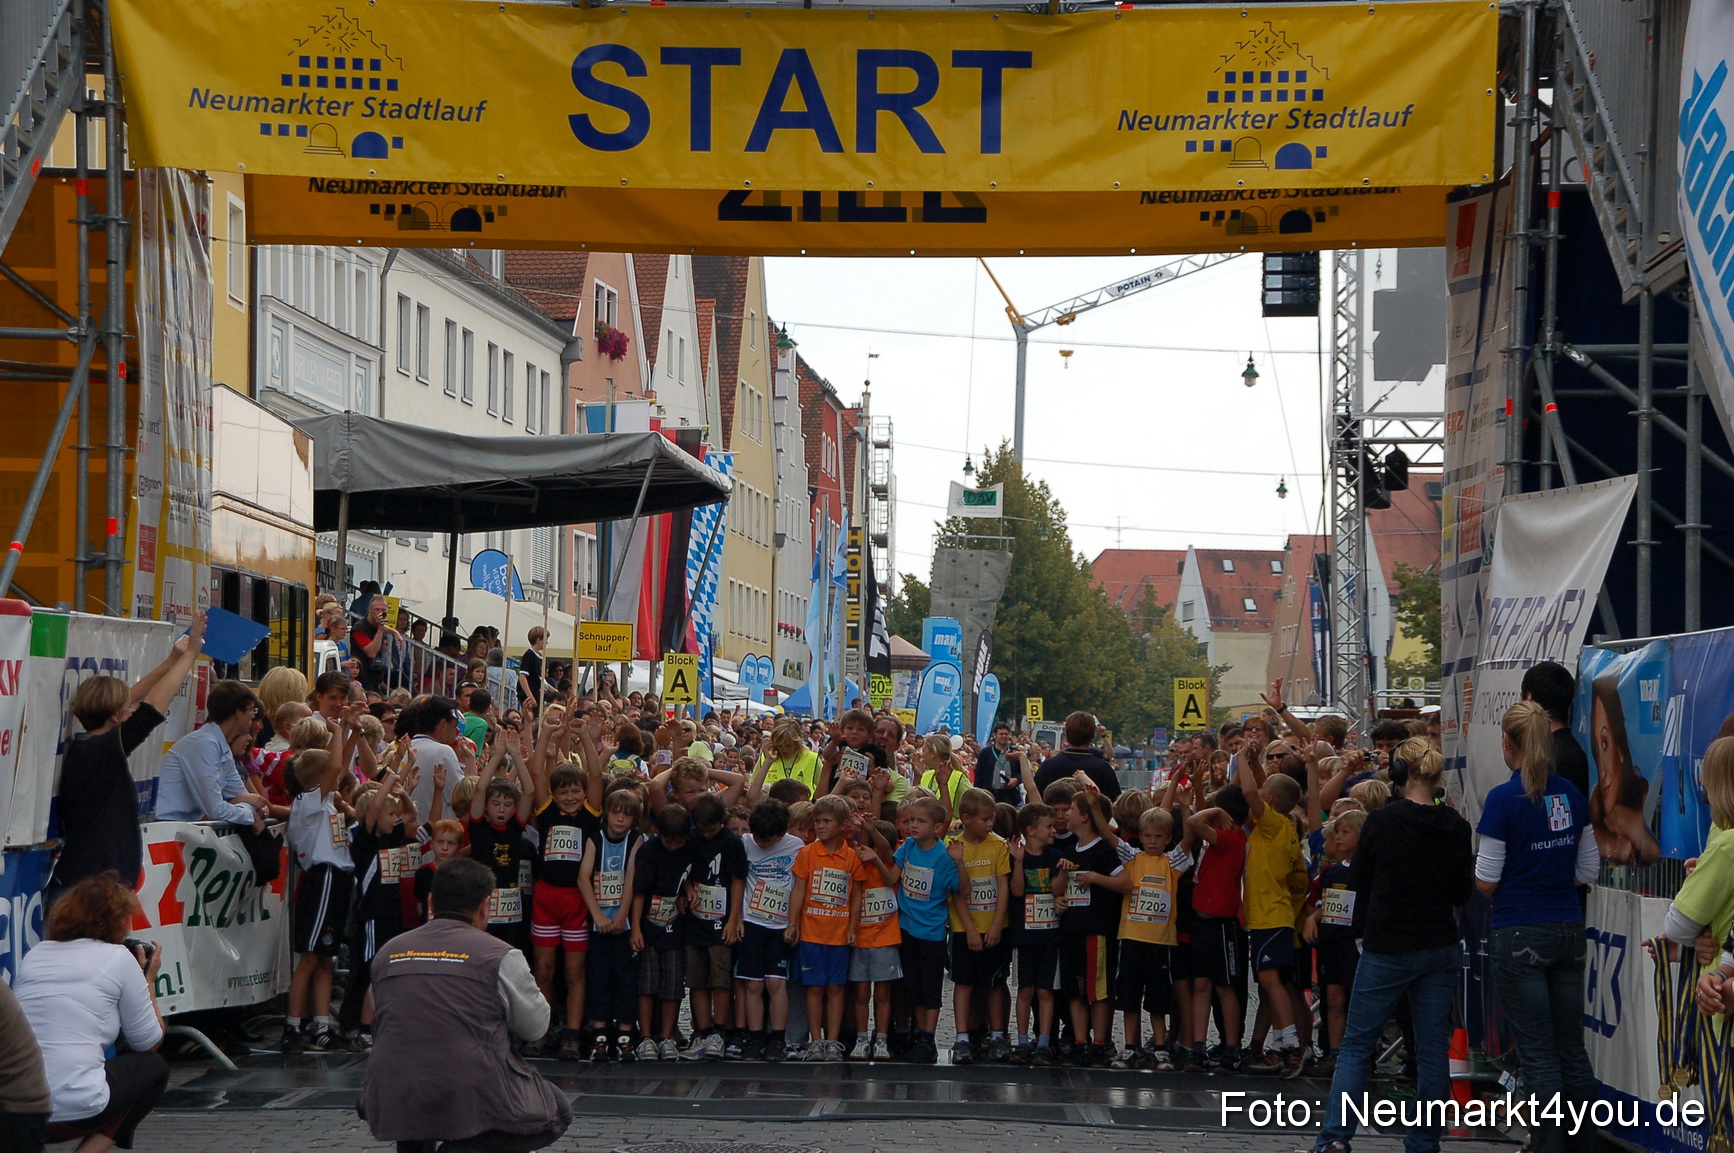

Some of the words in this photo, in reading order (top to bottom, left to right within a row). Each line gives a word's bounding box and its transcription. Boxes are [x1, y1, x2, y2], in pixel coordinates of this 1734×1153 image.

[188, 87, 354, 117] Neumarkter
[361, 95, 488, 123] Stadtlauf
[567, 43, 1033, 155] START
[1117, 107, 1279, 131] Neumarkter
[1285, 103, 1415, 129] Stadtlauf
[1117, 275, 1151, 293] POTAIN
[967, 491, 995, 504] DAV
[847, 528, 862, 646] HOTEL
[579, 631, 630, 643] Schnupper-
[934, 633, 958, 646] maxi
[595, 643, 612, 652] lauf
[667, 655, 694, 665] Block
[669, 668, 690, 694] A
[1178, 680, 1206, 690] Block
[1030, 704, 1040, 717] B
[1181, 693, 1203, 719] A
[841, 757, 865, 772] 7133
[552, 828, 571, 837] Lorenz
[553, 838, 579, 850] 7008
[1531, 834, 1574, 852] neumarkt
[965, 858, 992, 868] adidas
[601, 873, 619, 882] Stefan
[905, 874, 928, 891] 7220
[971, 878, 992, 887] Dominik
[765, 885, 785, 898] Markus
[823, 880, 847, 895] 7064
[972, 888, 997, 900] 7002
[1140, 887, 1160, 899] Nicolas
[865, 891, 876, 899] Jan
[500, 900, 521, 912] 7020
[698, 897, 722, 910] 7115
[763, 897, 788, 912] 7015
[866, 899, 894, 912] 7076
[1139, 899, 1167, 913] 7202
[1326, 902, 1350, 914] 7094
[806, 906, 831, 916] MERZ
